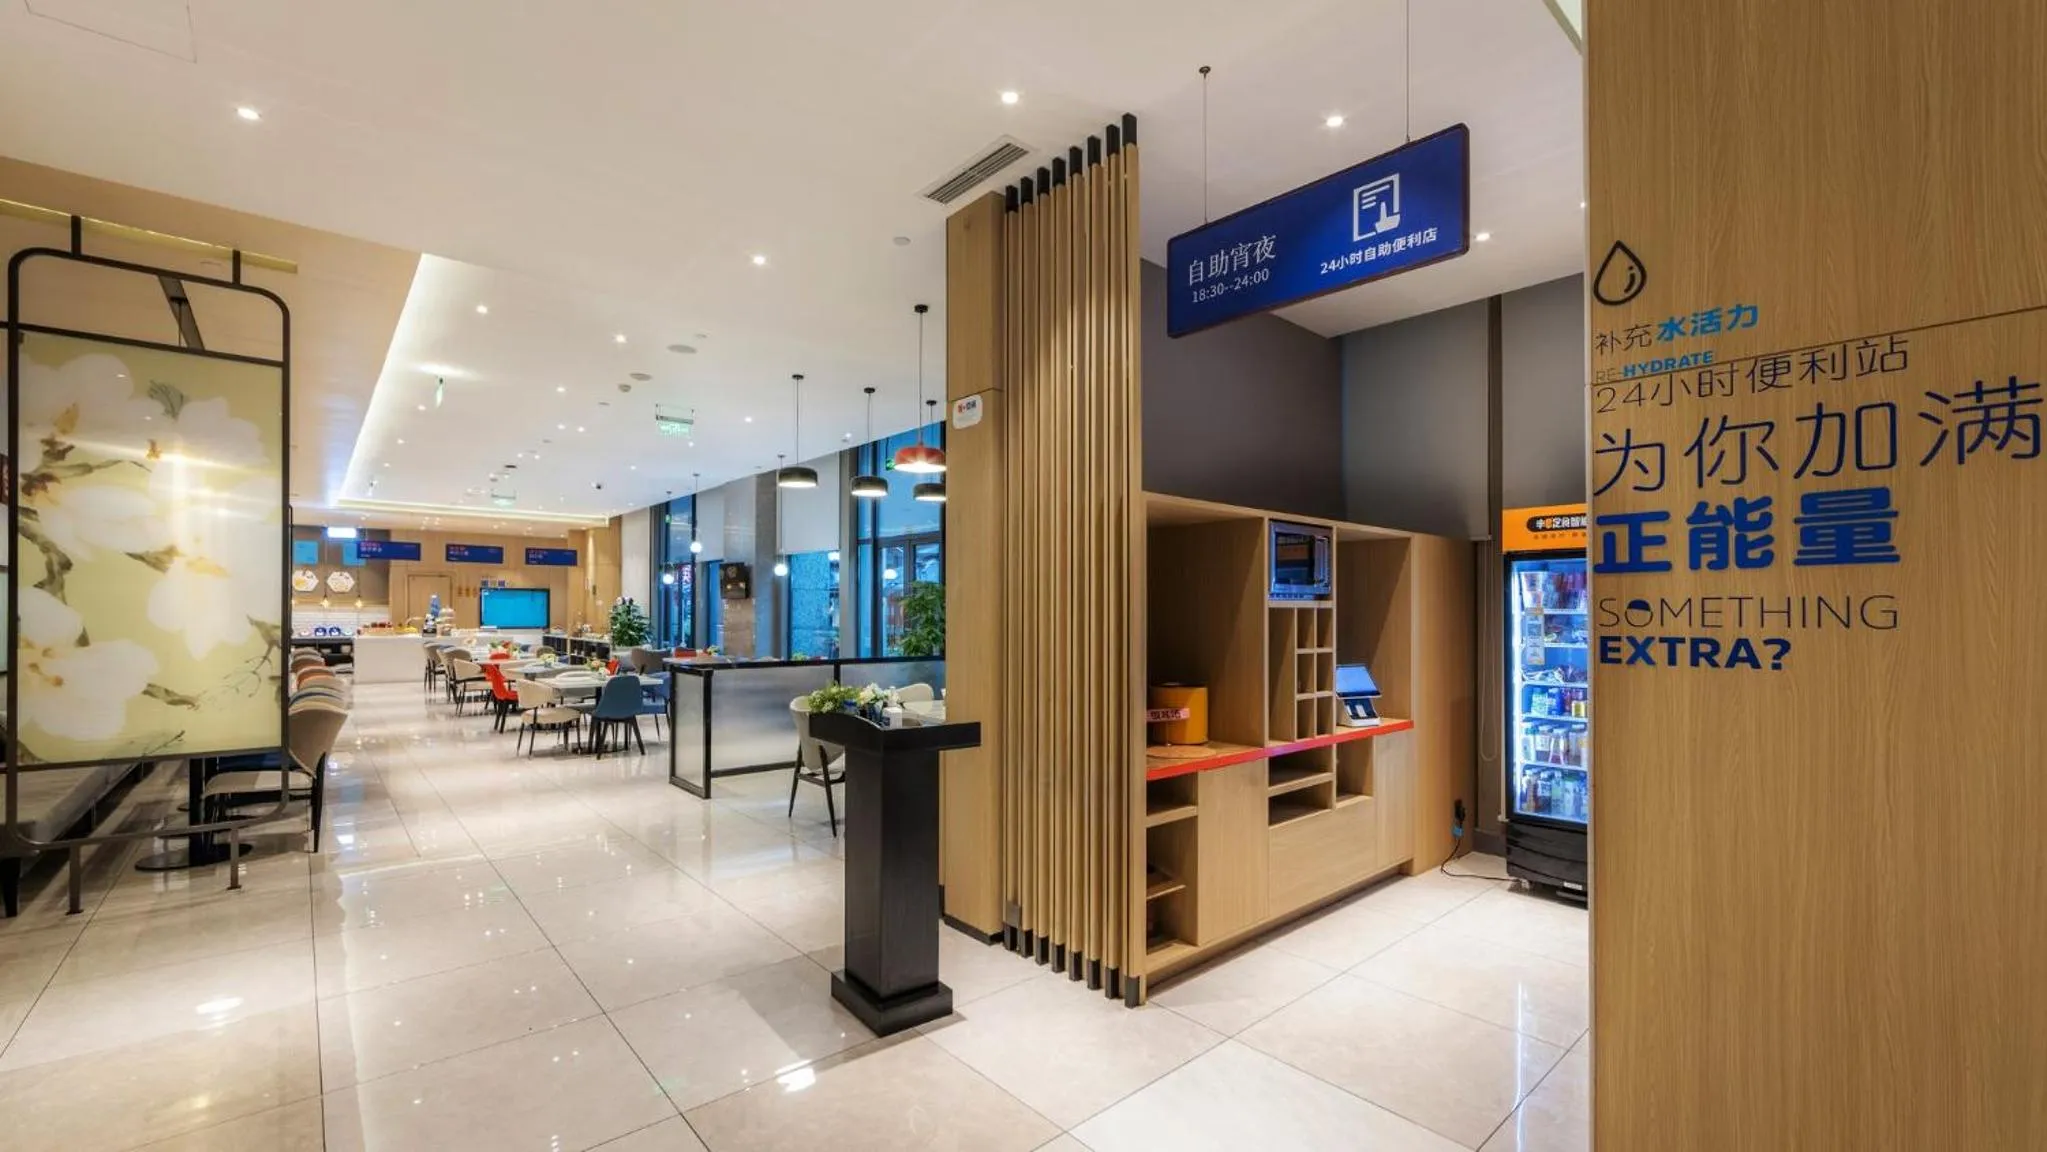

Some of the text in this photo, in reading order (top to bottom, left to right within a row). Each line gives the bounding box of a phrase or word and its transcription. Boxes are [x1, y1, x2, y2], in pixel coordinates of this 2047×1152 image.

[1188, 235, 1277, 286] 自助宵夜
[1320, 228, 1438, 275] 24小时自助便利店
[1192, 269, 1269, 303] 18:30--24:00
[1596, 336, 1910, 414] 24小时便利站
[1593, 376, 2043, 496] 为你加满
[1593, 487, 1901, 574] 正能量
[1598, 595, 1899, 630] SOMETHING
[1599, 636, 1792, 671] EXTRA?
